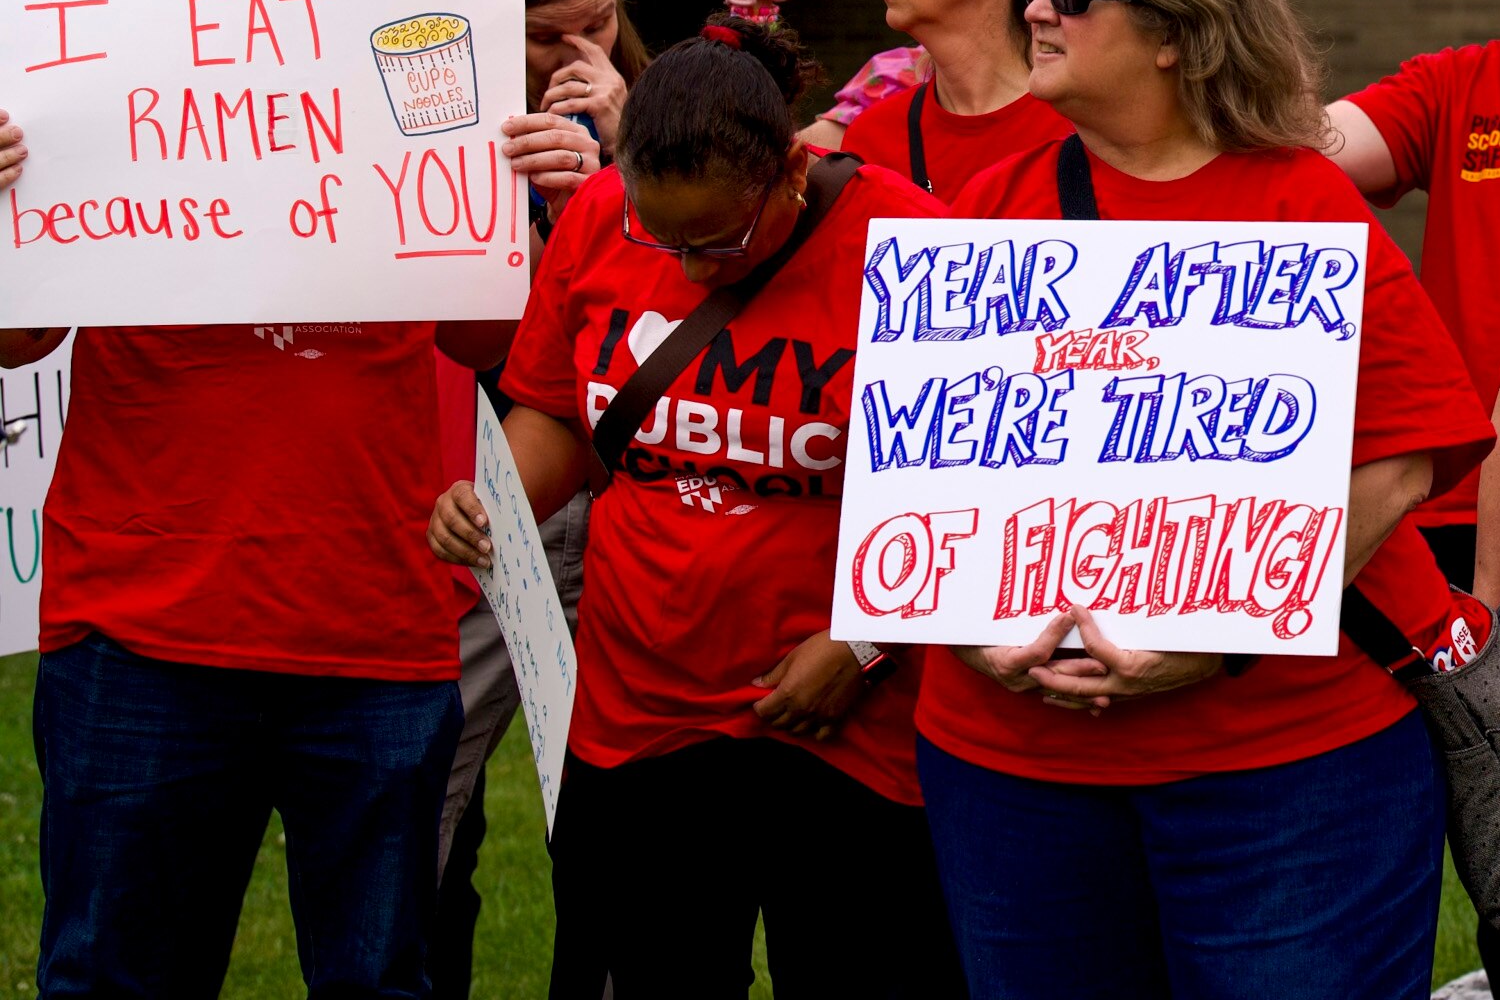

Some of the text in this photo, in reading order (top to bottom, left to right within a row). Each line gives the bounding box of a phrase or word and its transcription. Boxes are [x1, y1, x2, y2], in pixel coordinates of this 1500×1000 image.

[128, 87, 343, 163] RAMEN
[403, 87, 464, 112] NOODLES
[10, 116, 525, 269] because of YOU!
[294, 325, 362, 335] ASSOCIATION
[864, 237, 1359, 343] YEAR AFTER,
[592, 308, 857, 415] I MY
[1033, 328, 1160, 375] YEAR,
[862, 366, 1317, 473] WE'RE TIRED
[852, 494, 1344, 640] OF FIGHTING!
[556, 640, 571, 697] NOT
